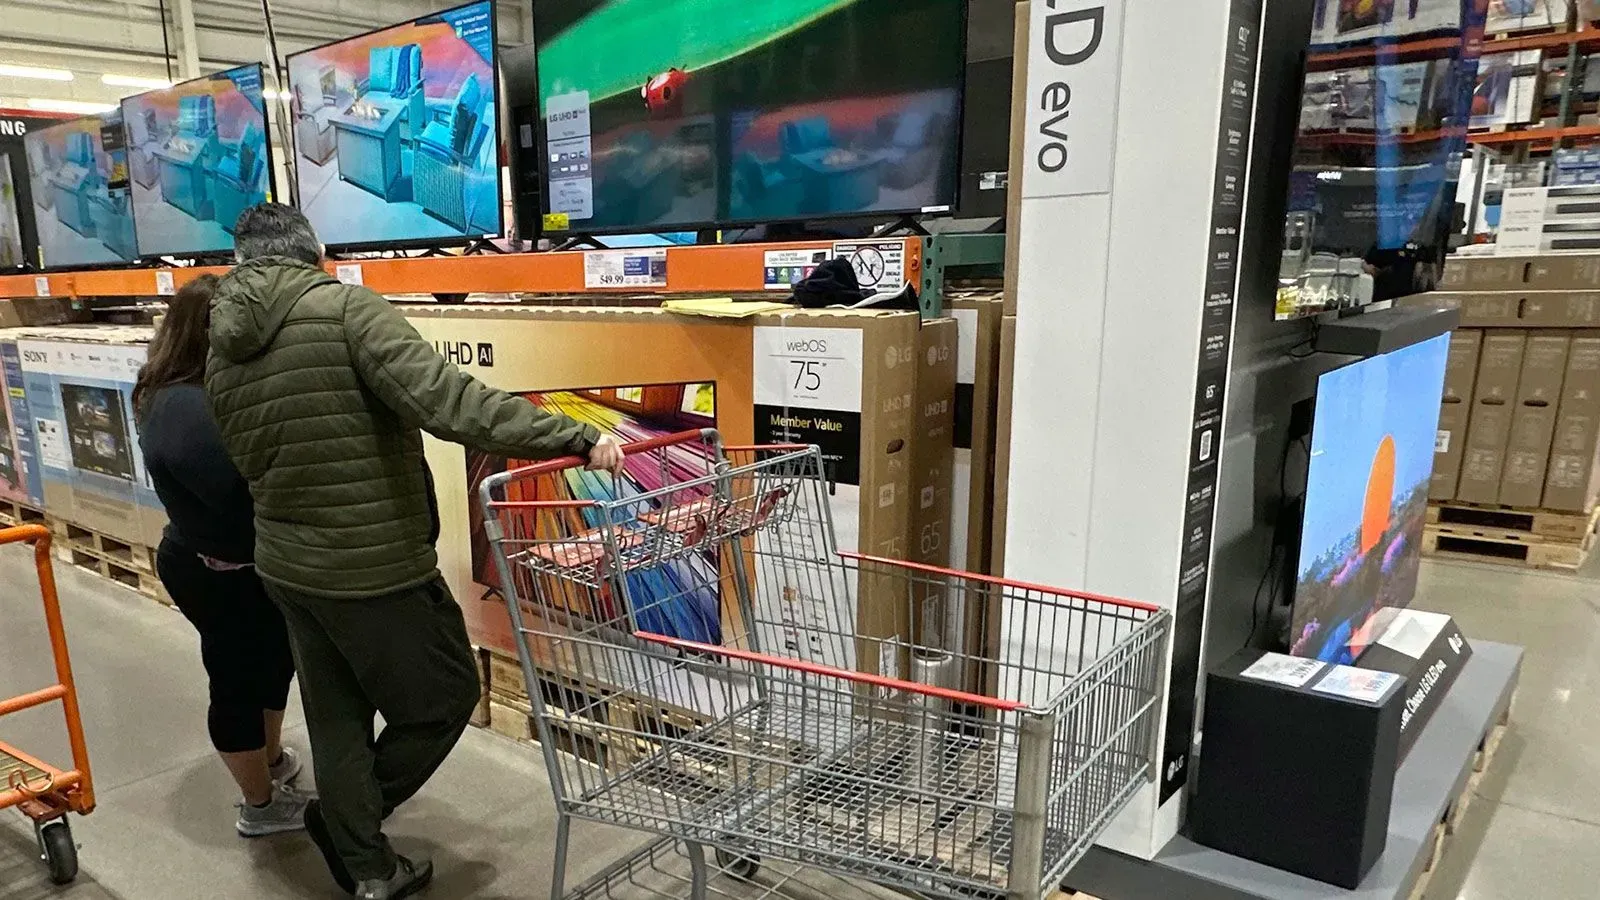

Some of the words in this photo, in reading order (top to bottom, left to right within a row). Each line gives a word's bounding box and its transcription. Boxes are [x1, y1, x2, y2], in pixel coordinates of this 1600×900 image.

[1044, 0, 1105, 66] D
[1037, 81, 1071, 173] evo
[435, 340, 473, 366] UHD
[479, 345, 492, 365] AI
[786, 339, 827, 353] webOS
[23, 351, 48, 363] SONY
[770, 414, 811, 428] Member
[814, 418, 843, 432] Value
[1419, 677, 1431, 694] LG
[1175, 754, 1185, 772] LG
